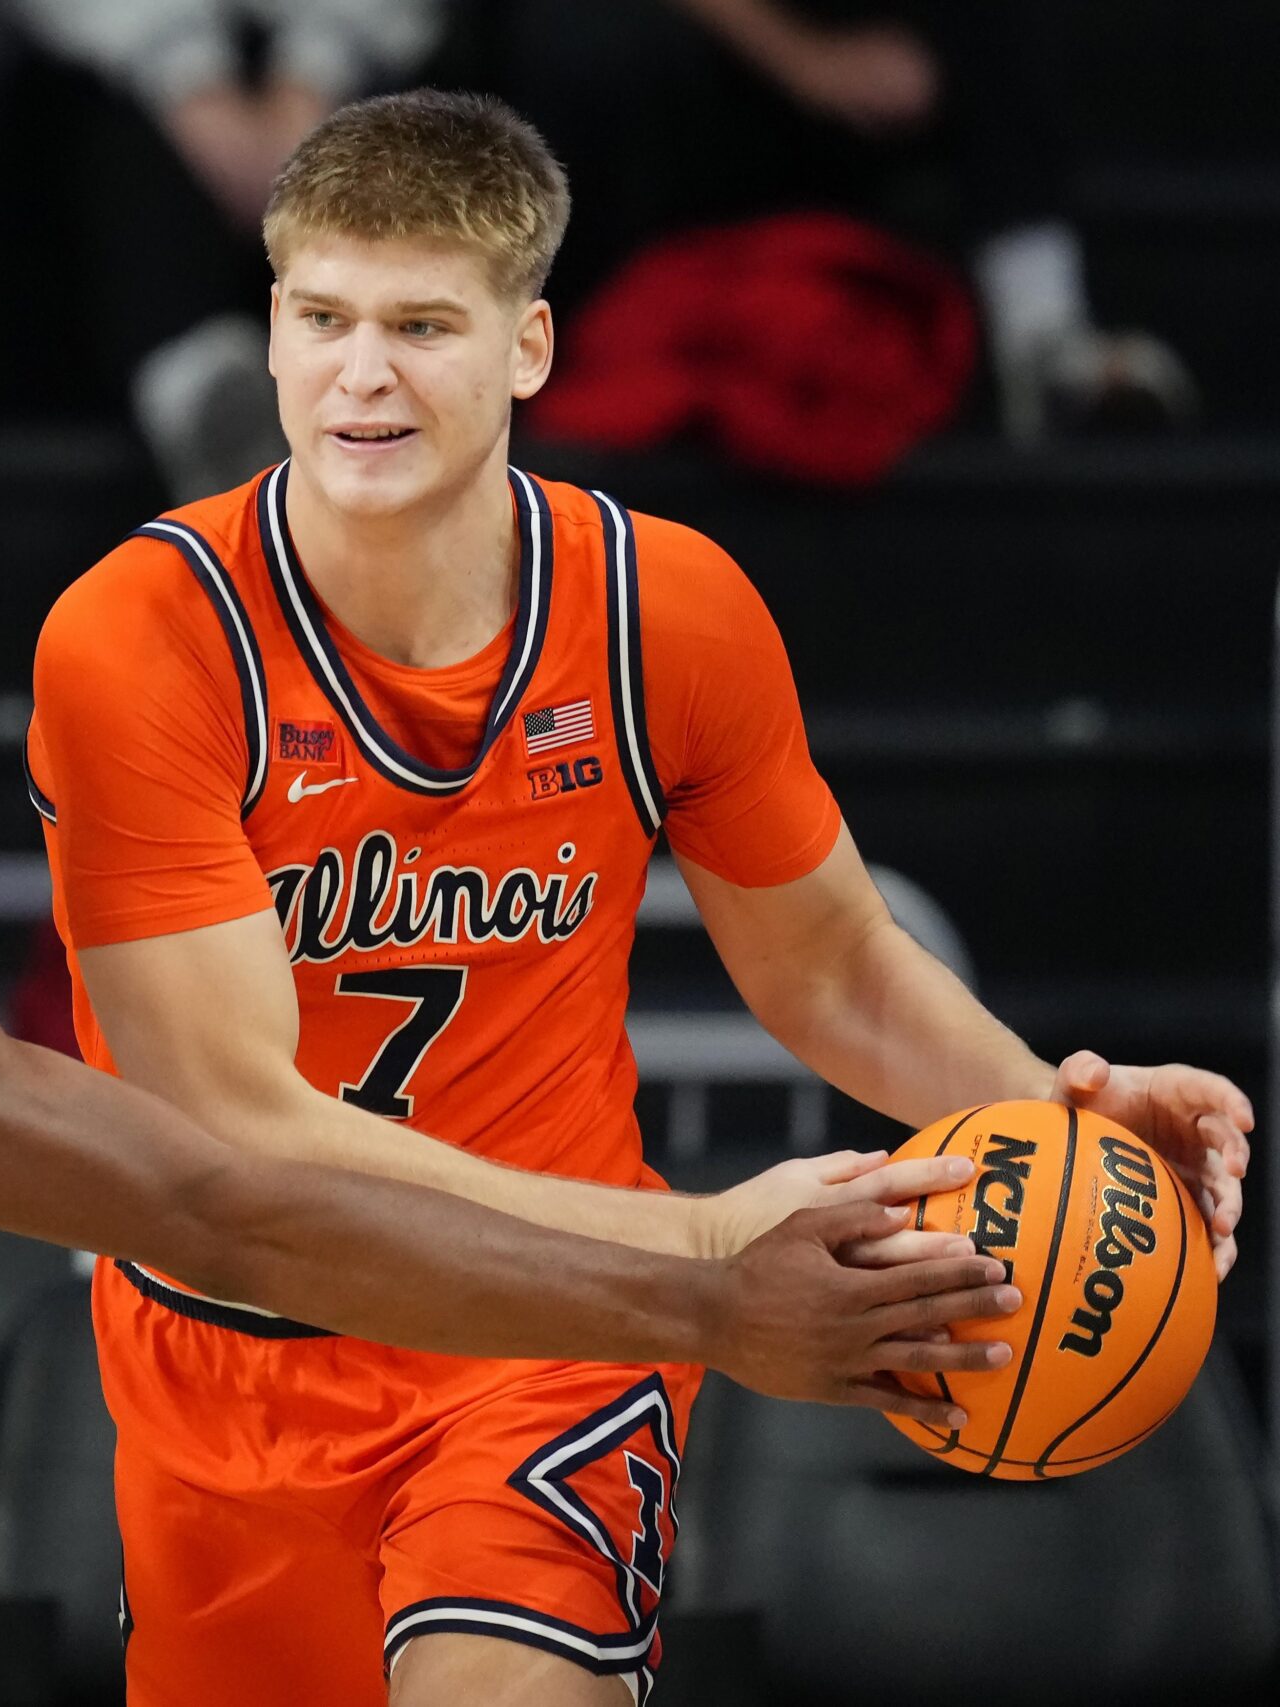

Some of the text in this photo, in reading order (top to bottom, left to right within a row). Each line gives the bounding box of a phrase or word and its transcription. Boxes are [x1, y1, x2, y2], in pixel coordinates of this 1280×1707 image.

[280, 743, 326, 762] BANK
[334, 964, 469, 1118] 7
[967, 1133, 1038, 1285] NCA
[1057, 1136, 1158, 1358] Wilson
